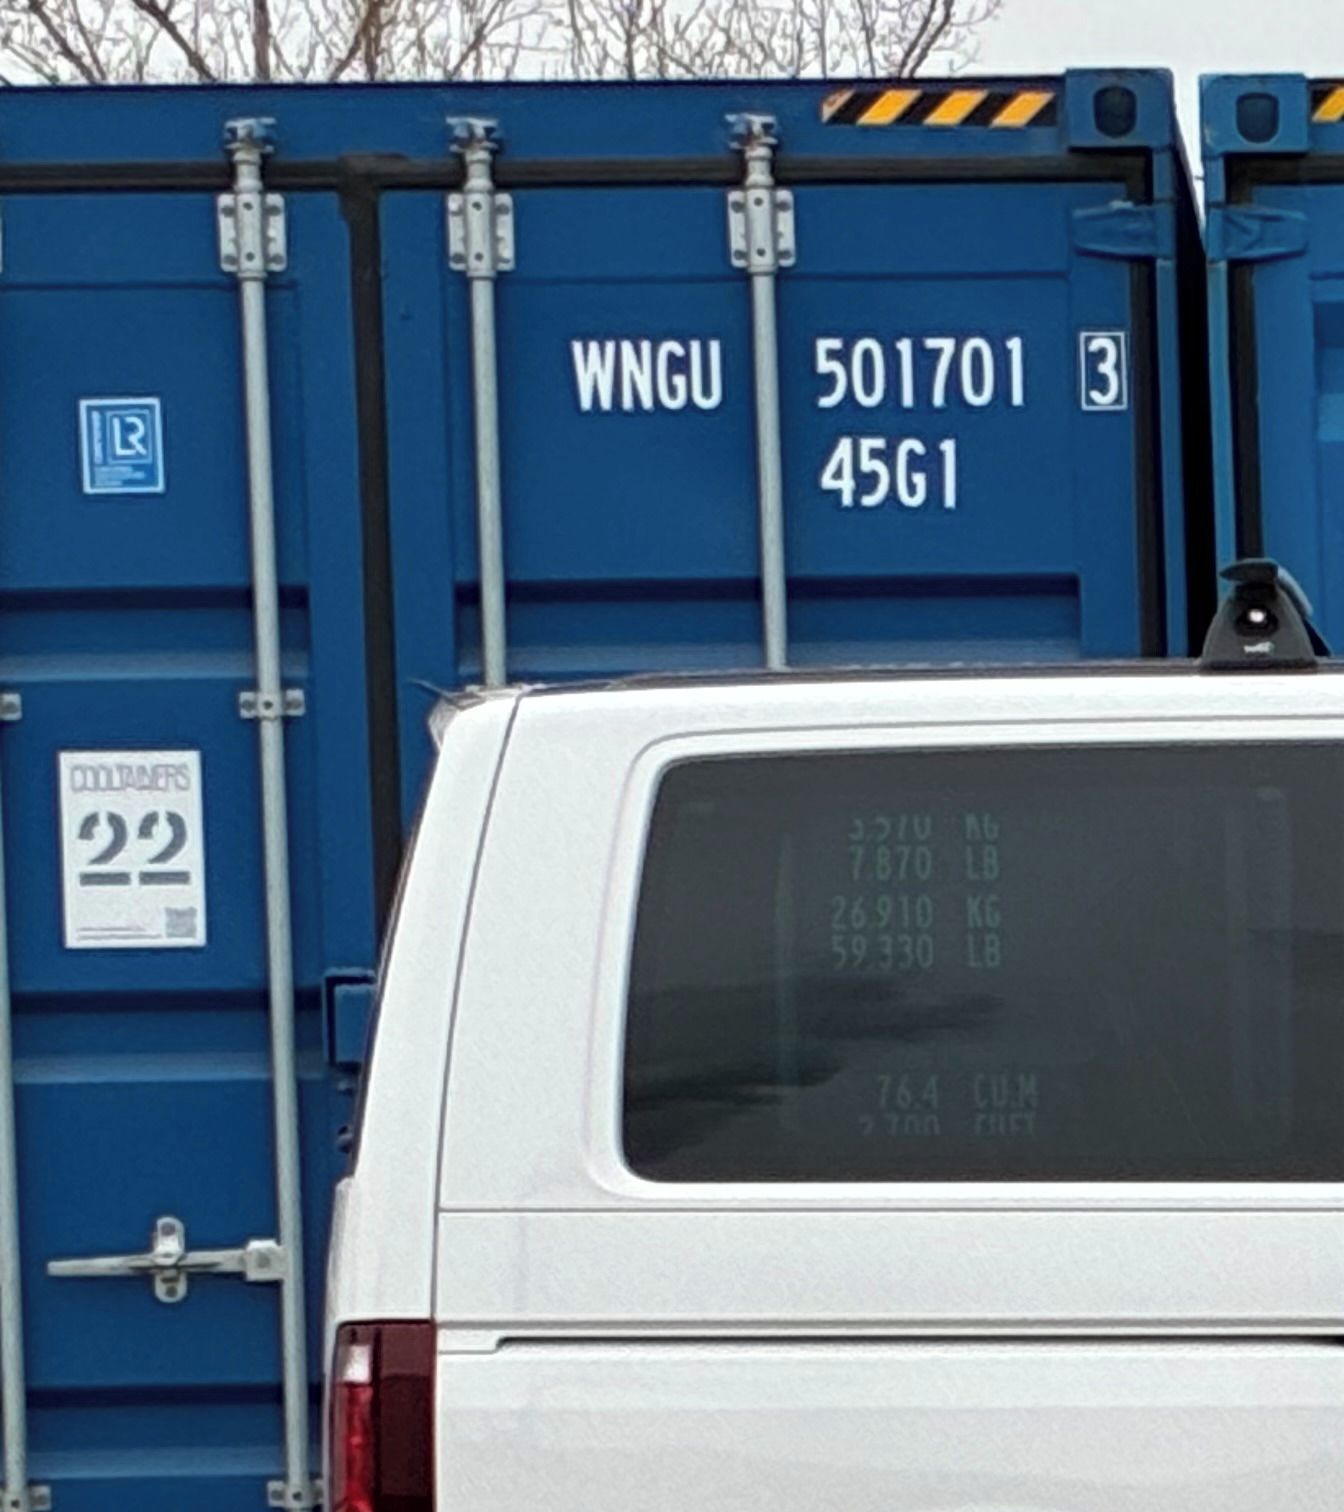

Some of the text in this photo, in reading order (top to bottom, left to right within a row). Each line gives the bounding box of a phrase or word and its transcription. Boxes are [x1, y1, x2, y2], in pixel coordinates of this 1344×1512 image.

[572, 337, 1119, 411] WNGU 501701 3
[820, 436, 956, 509] 45G1
[78, 811, 191, 887] 22
